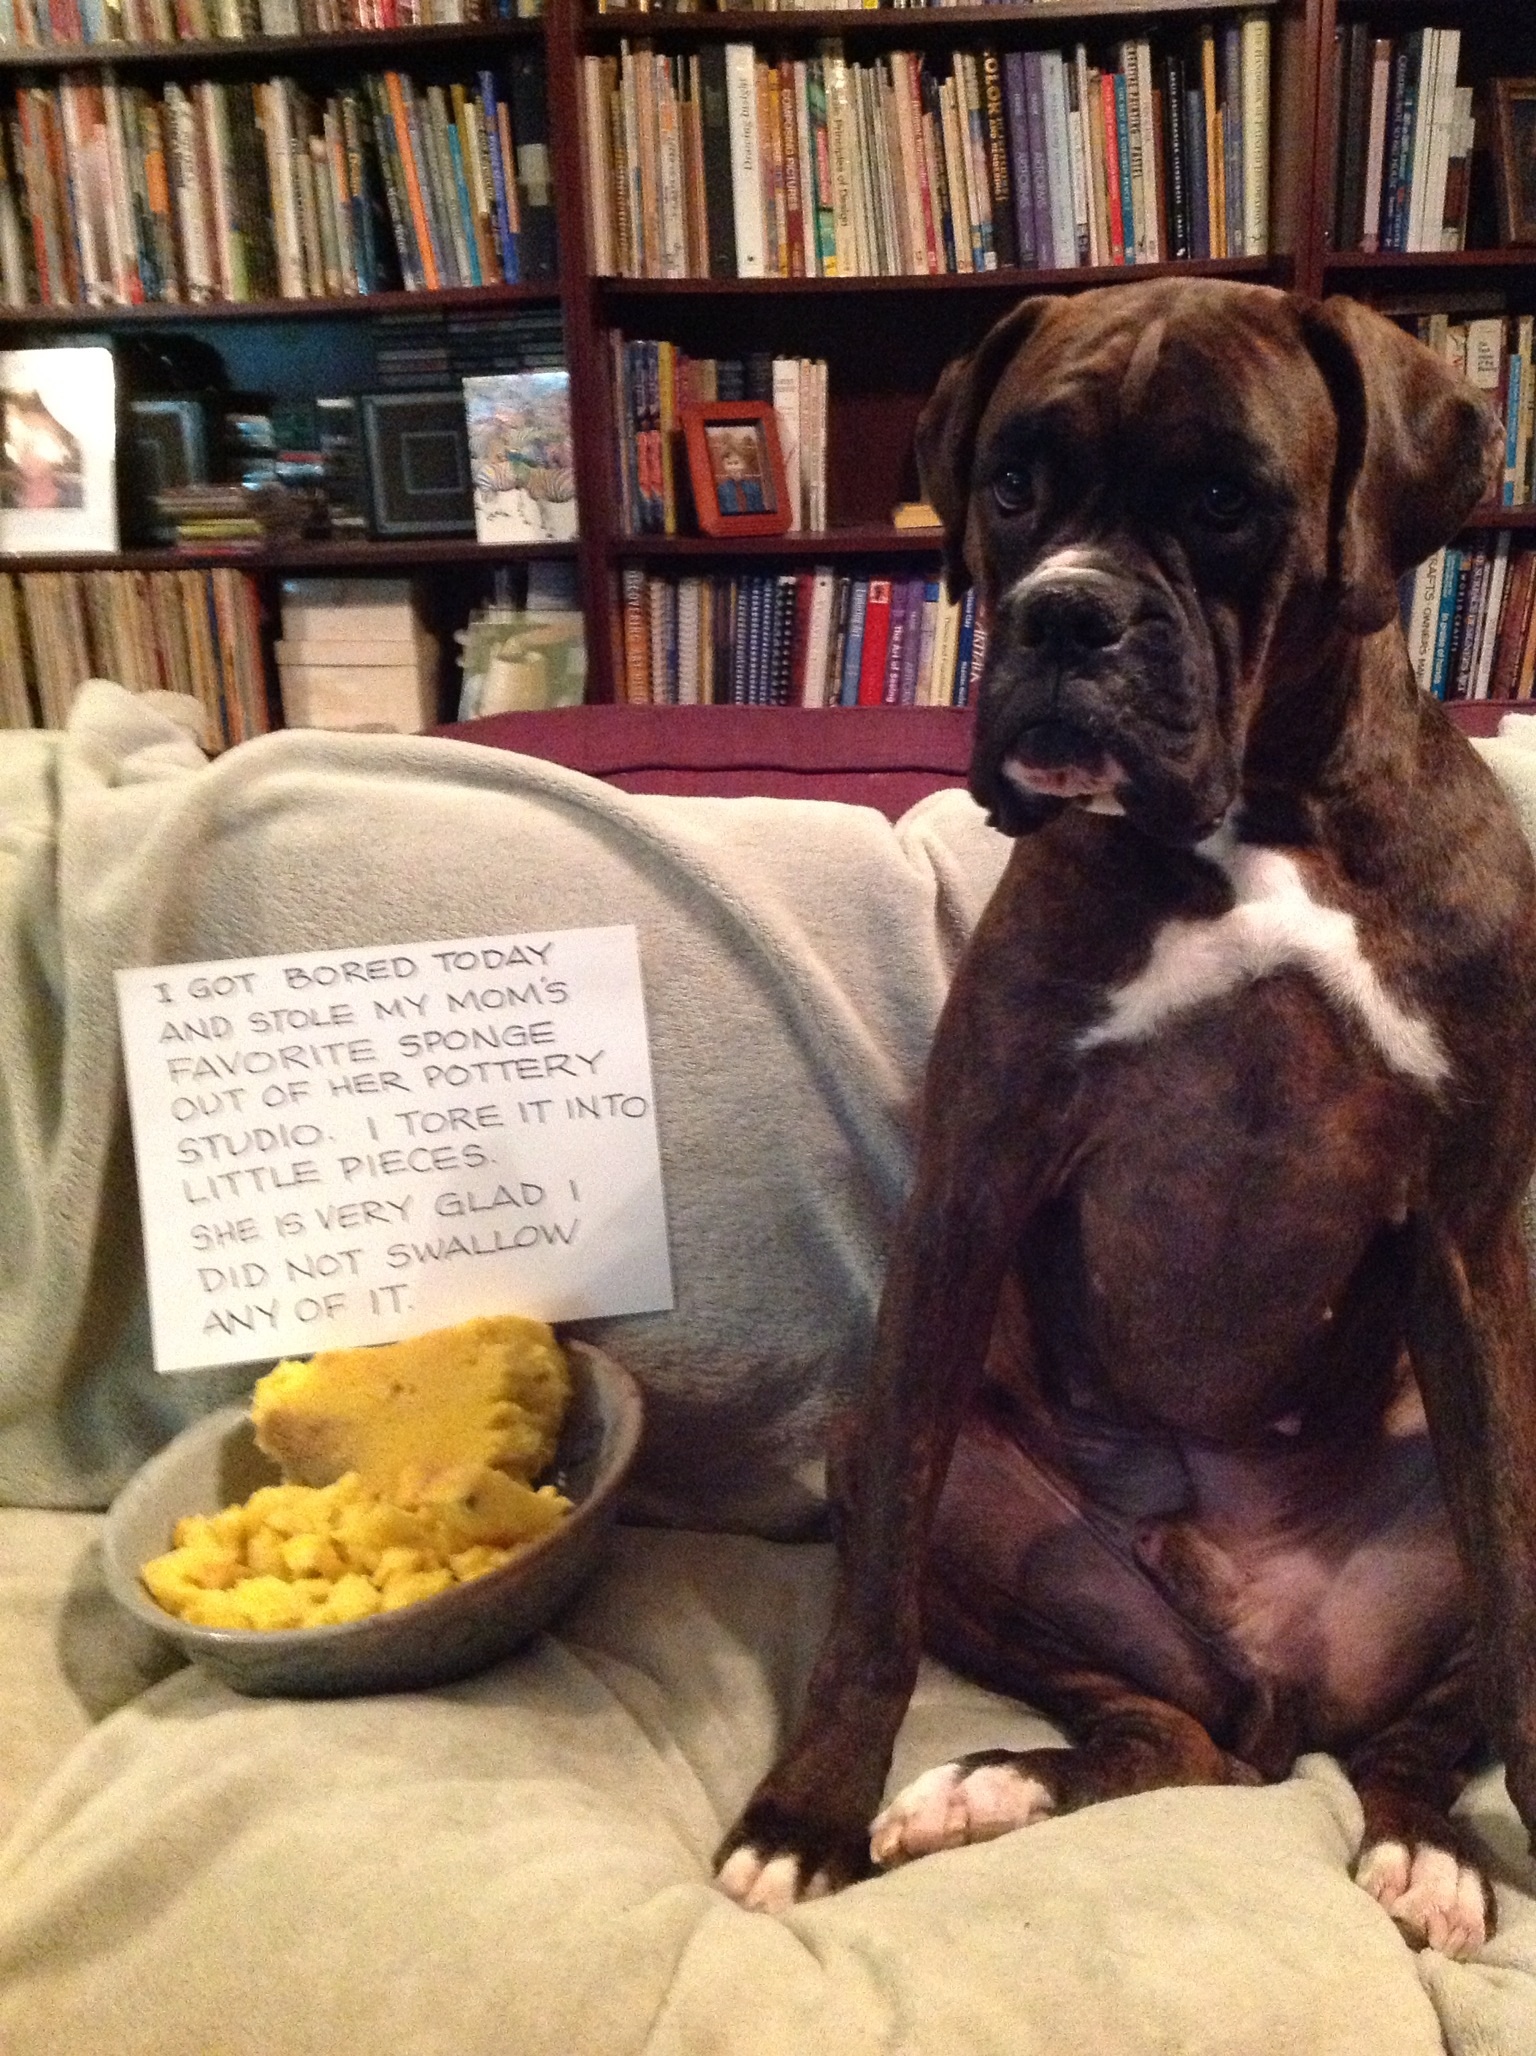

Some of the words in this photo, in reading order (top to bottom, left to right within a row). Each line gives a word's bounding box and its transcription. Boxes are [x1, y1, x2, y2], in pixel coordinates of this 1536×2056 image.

[782, 89, 796, 156] COMPOSING
[786, 157, 799, 211] PICTURES
[890, 643, 902, 659] Art
[892, 625, 903, 642] The
[963, 614, 973, 629] Clay
[1437, 622, 1448, 648] praise
[885, 672, 899, 703] Seeing
[1433, 657, 1445, 685] hands
[153, 982, 174, 1004] I
[188, 973, 256, 1000] GOT
[283, 957, 417, 990] BORED
[431, 942, 553, 972] TODAY
[159, 1016, 233, 1043] AND
[249, 1004, 354, 1033] STOLE
[374, 994, 428, 1019] MY
[446, 978, 569, 1012] MOM'S
[165, 1036, 376, 1085] FAVORITE
[398, 1021, 558, 1060] SPONGE
[173, 1088, 245, 1122] OUT
[262, 1081, 309, 1108] OF
[329, 1071, 411, 1096] HER
[423, 1047, 605, 1088] POTTERY
[178, 1124, 333, 1168] STUDIO.
[367, 1117, 375, 1140] I
[395, 1104, 505, 1135] TORE
[518, 1099, 553, 1123] IT
[566, 1093, 649, 1119] INTO
[181, 1159, 321, 1204] LITTLE
[338, 1144, 496, 1181] PIECES.
[191, 1218, 259, 1251] SHE
[276, 1212, 305, 1237] IS
[316, 1195, 411, 1230] VERY
[435, 1182, 546, 1217] GLAD
[569, 1180, 580, 1201] I
[197, 1263, 268, 1293] DID
[286, 1249, 362, 1281] NOT
[385, 1217, 578, 1269] SWALLOW
[204, 1303, 276, 1335] ANY
[296, 1293, 344, 1323] OF
[370, 1284, 412, 1315] IT.
